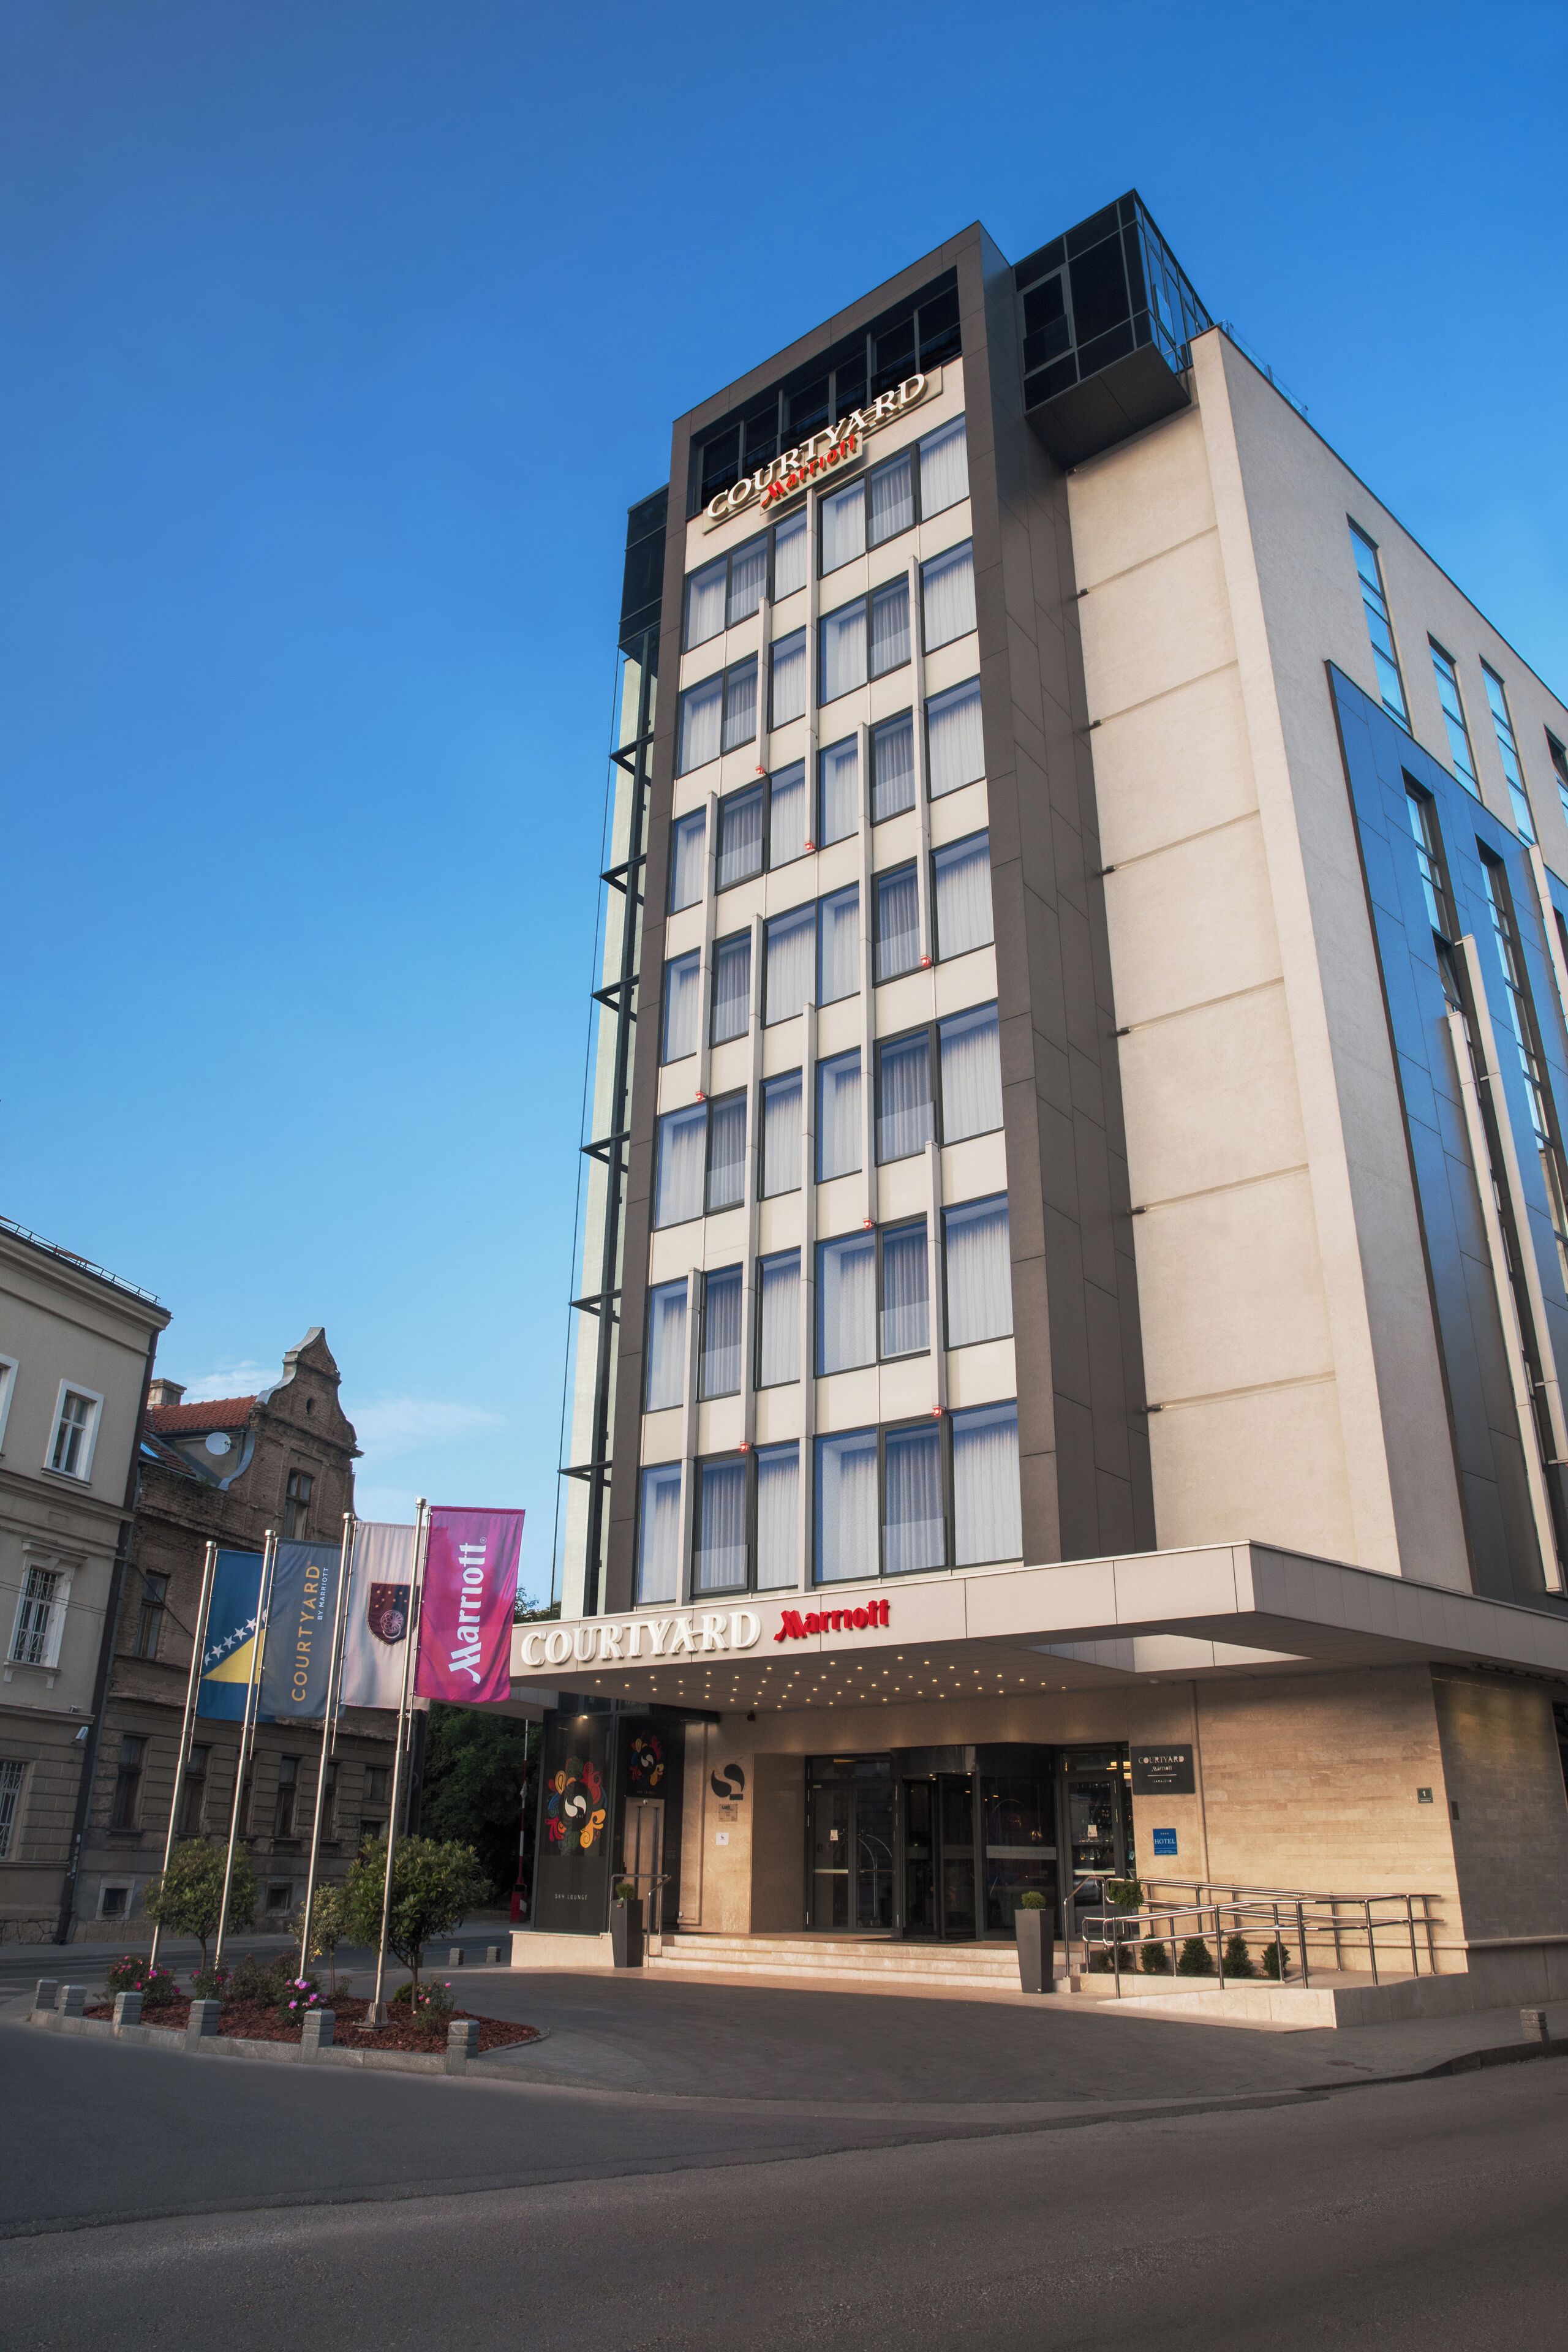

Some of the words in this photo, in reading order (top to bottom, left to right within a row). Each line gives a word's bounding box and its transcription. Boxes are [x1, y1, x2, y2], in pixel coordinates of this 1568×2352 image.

[707, 374, 927, 520] COURTYARD
[761, 433, 859, 509] Marriott
[317, 1610, 324, 1620] BY
[319, 1567, 329, 1608] MARRIOTT
[448, 1542, 487, 1684] Marriott
[292, 1566, 320, 1702] COURTYARD
[521, 1611, 761, 1666] COURTYARD
[774, 1599, 891, 1643] Marriott
[1138, 1755, 1185, 1764] COURTYARD
